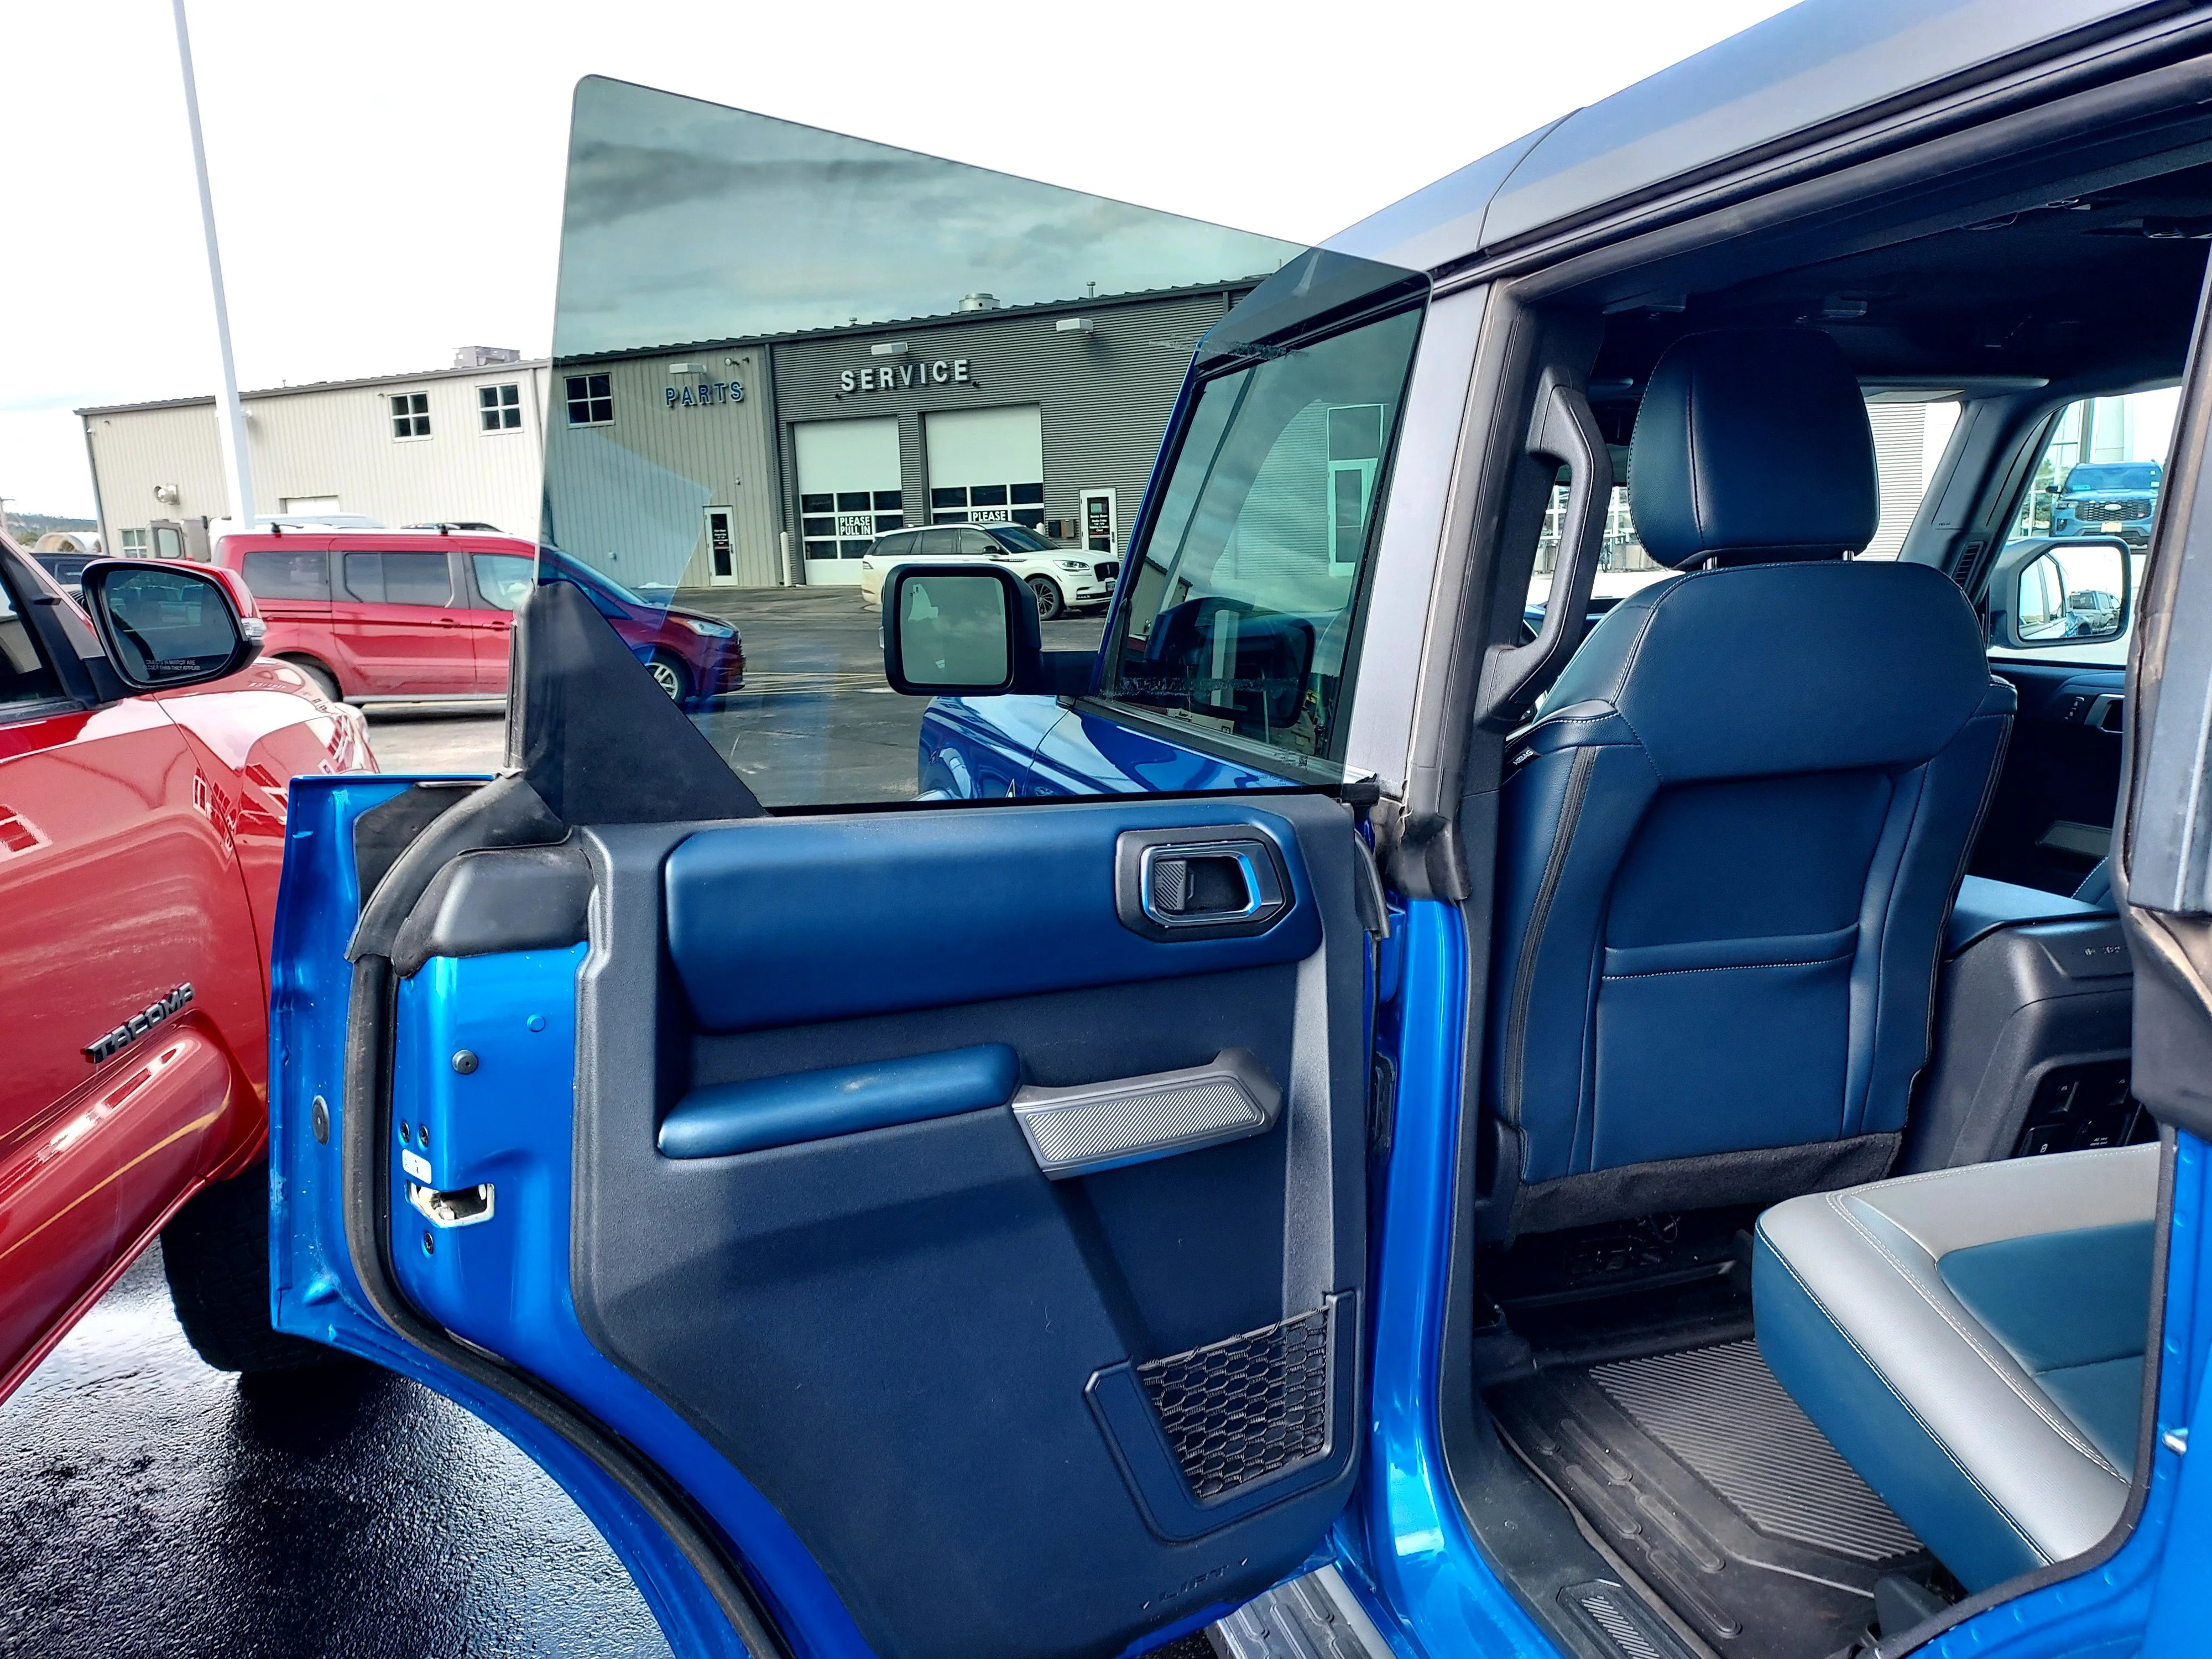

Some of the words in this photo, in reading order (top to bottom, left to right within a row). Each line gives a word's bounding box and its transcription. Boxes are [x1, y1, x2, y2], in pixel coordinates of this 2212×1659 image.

[841, 359, 968, 392] SERVICE
[665, 380, 744, 408] PARTS
[839, 516, 870, 526] PLEASE
[972, 510, 1006, 521] PLEASE
[840, 525, 859, 535] PULL
[861, 525, 870, 535] IN
[86, 982, 195, 1063] TACOMA
